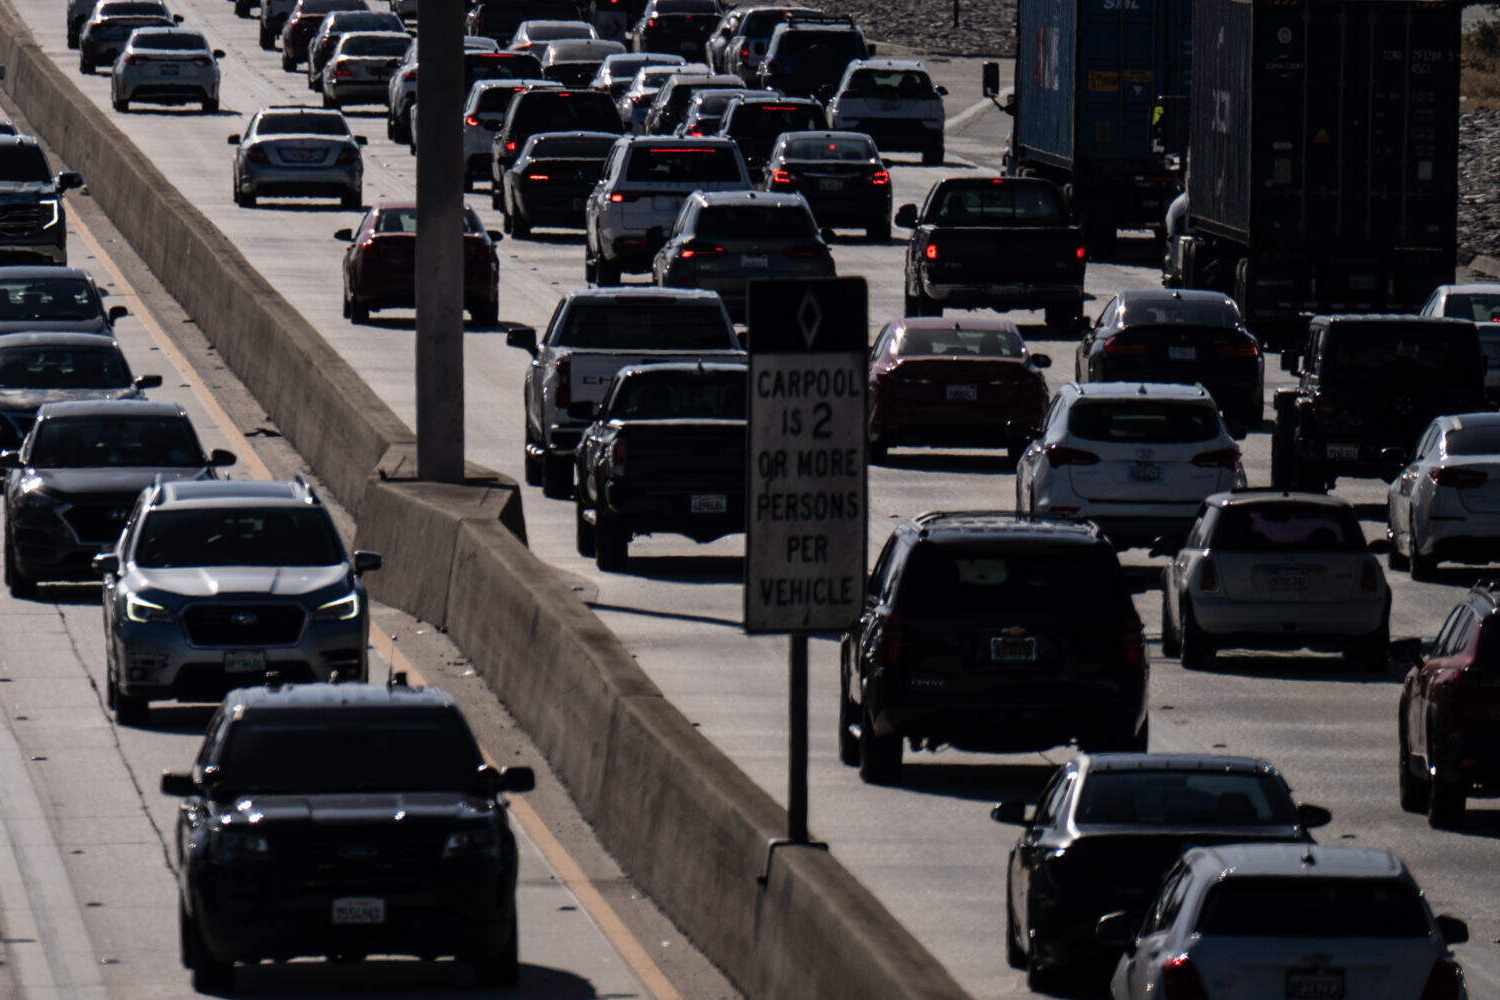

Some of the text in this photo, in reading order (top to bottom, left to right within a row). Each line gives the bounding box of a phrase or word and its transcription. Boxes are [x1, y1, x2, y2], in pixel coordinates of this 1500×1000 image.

[757, 369, 861, 399] CARPOOL
[781, 402, 833, 438] IS 2
[758, 450, 858, 479] OR MORE
[757, 492, 858, 522] PERSONS
[786, 534, 828, 563] PER
[759, 576, 853, 606] VEHICLE
